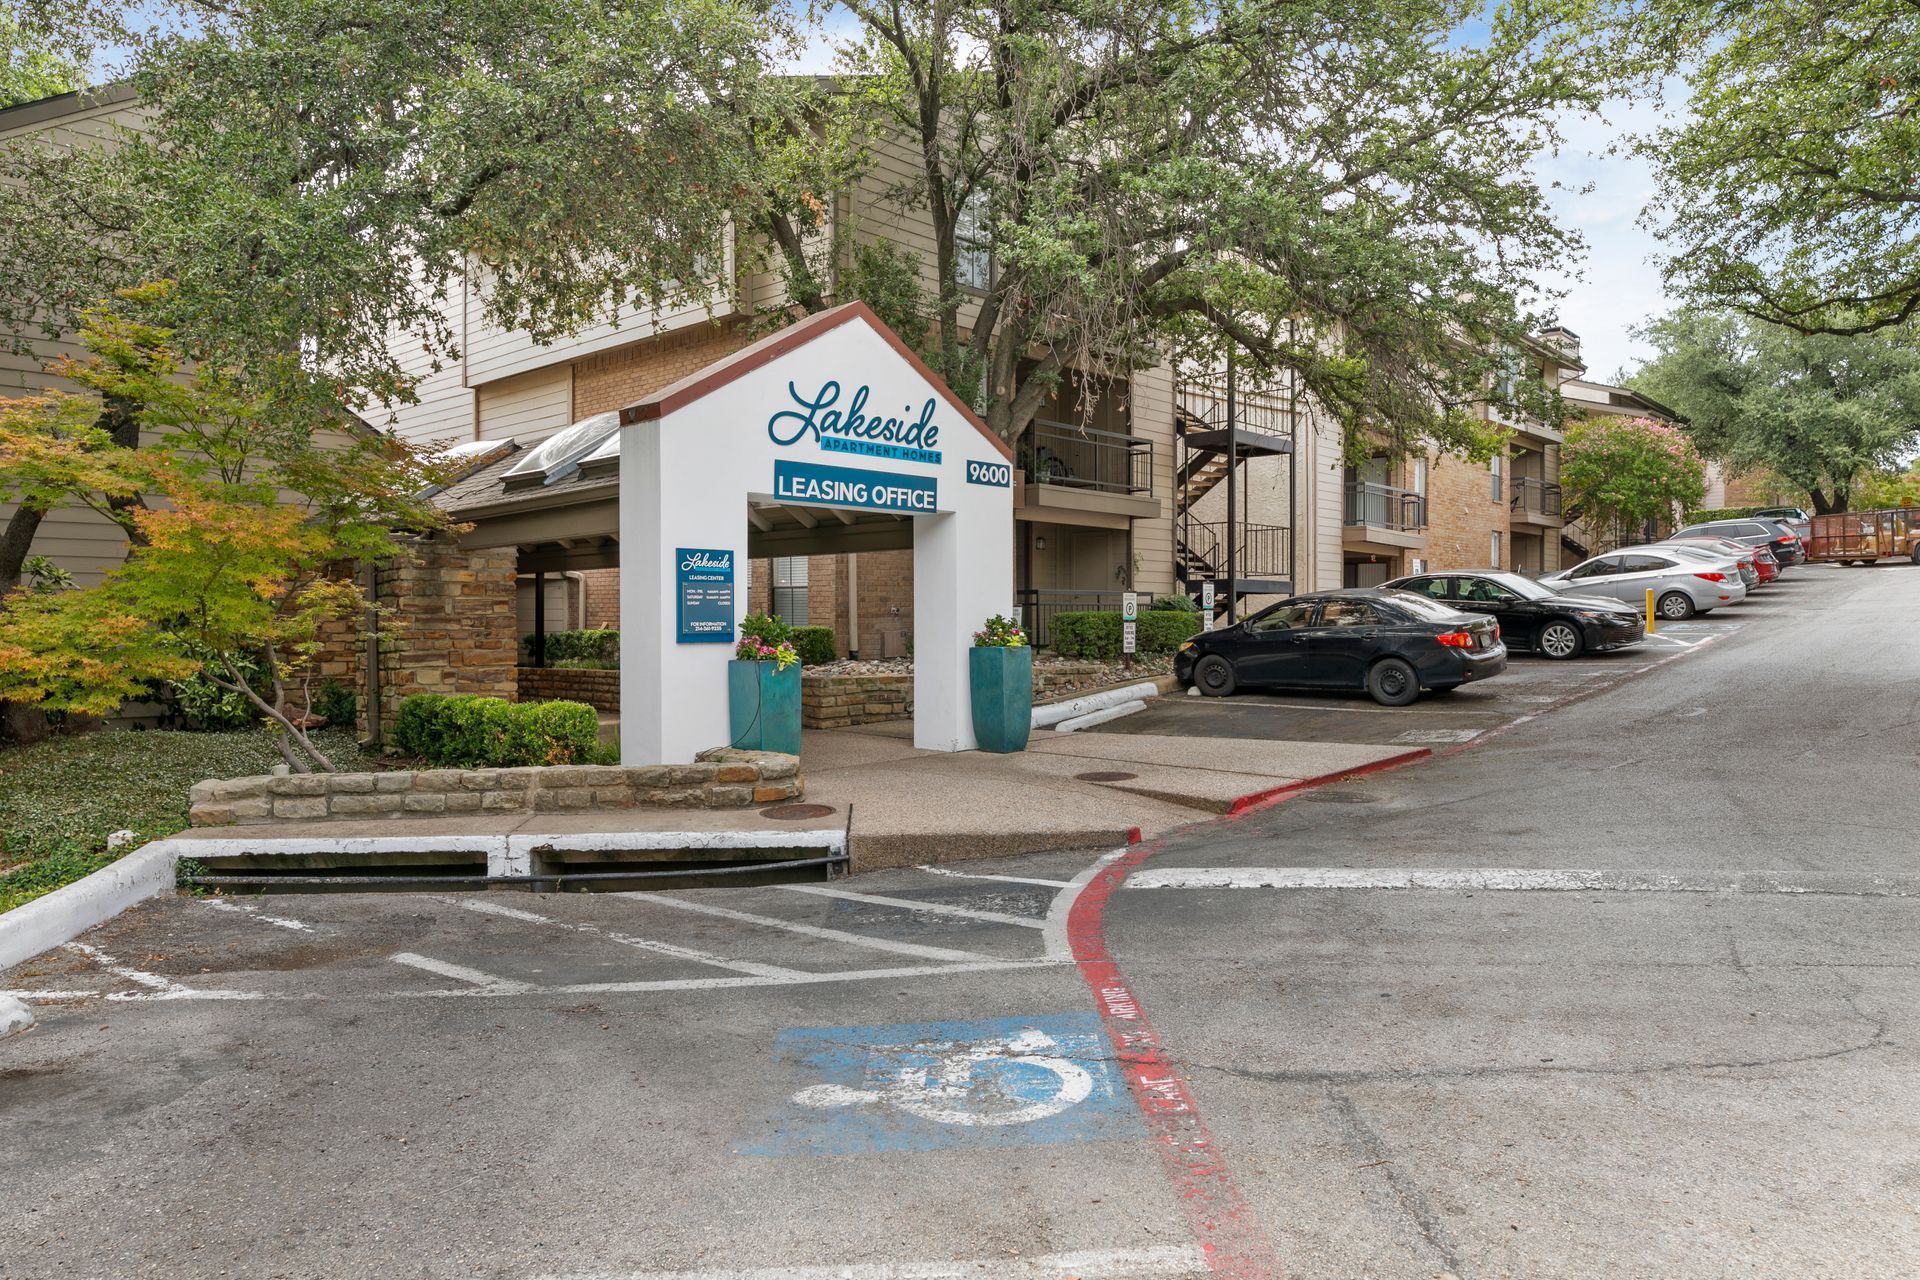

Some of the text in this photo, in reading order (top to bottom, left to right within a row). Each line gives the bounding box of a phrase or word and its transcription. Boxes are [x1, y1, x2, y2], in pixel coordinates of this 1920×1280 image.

[768, 380, 939, 449] Lakeside
[823, 438, 942, 463] APARTMENT HOMES
[969, 463, 1009, 484] 9600
[778, 475, 935, 509] LEASING OFFICE
[681, 552, 730, 571] Lakeside
[1101, 987, 1137, 1020] ARKING
